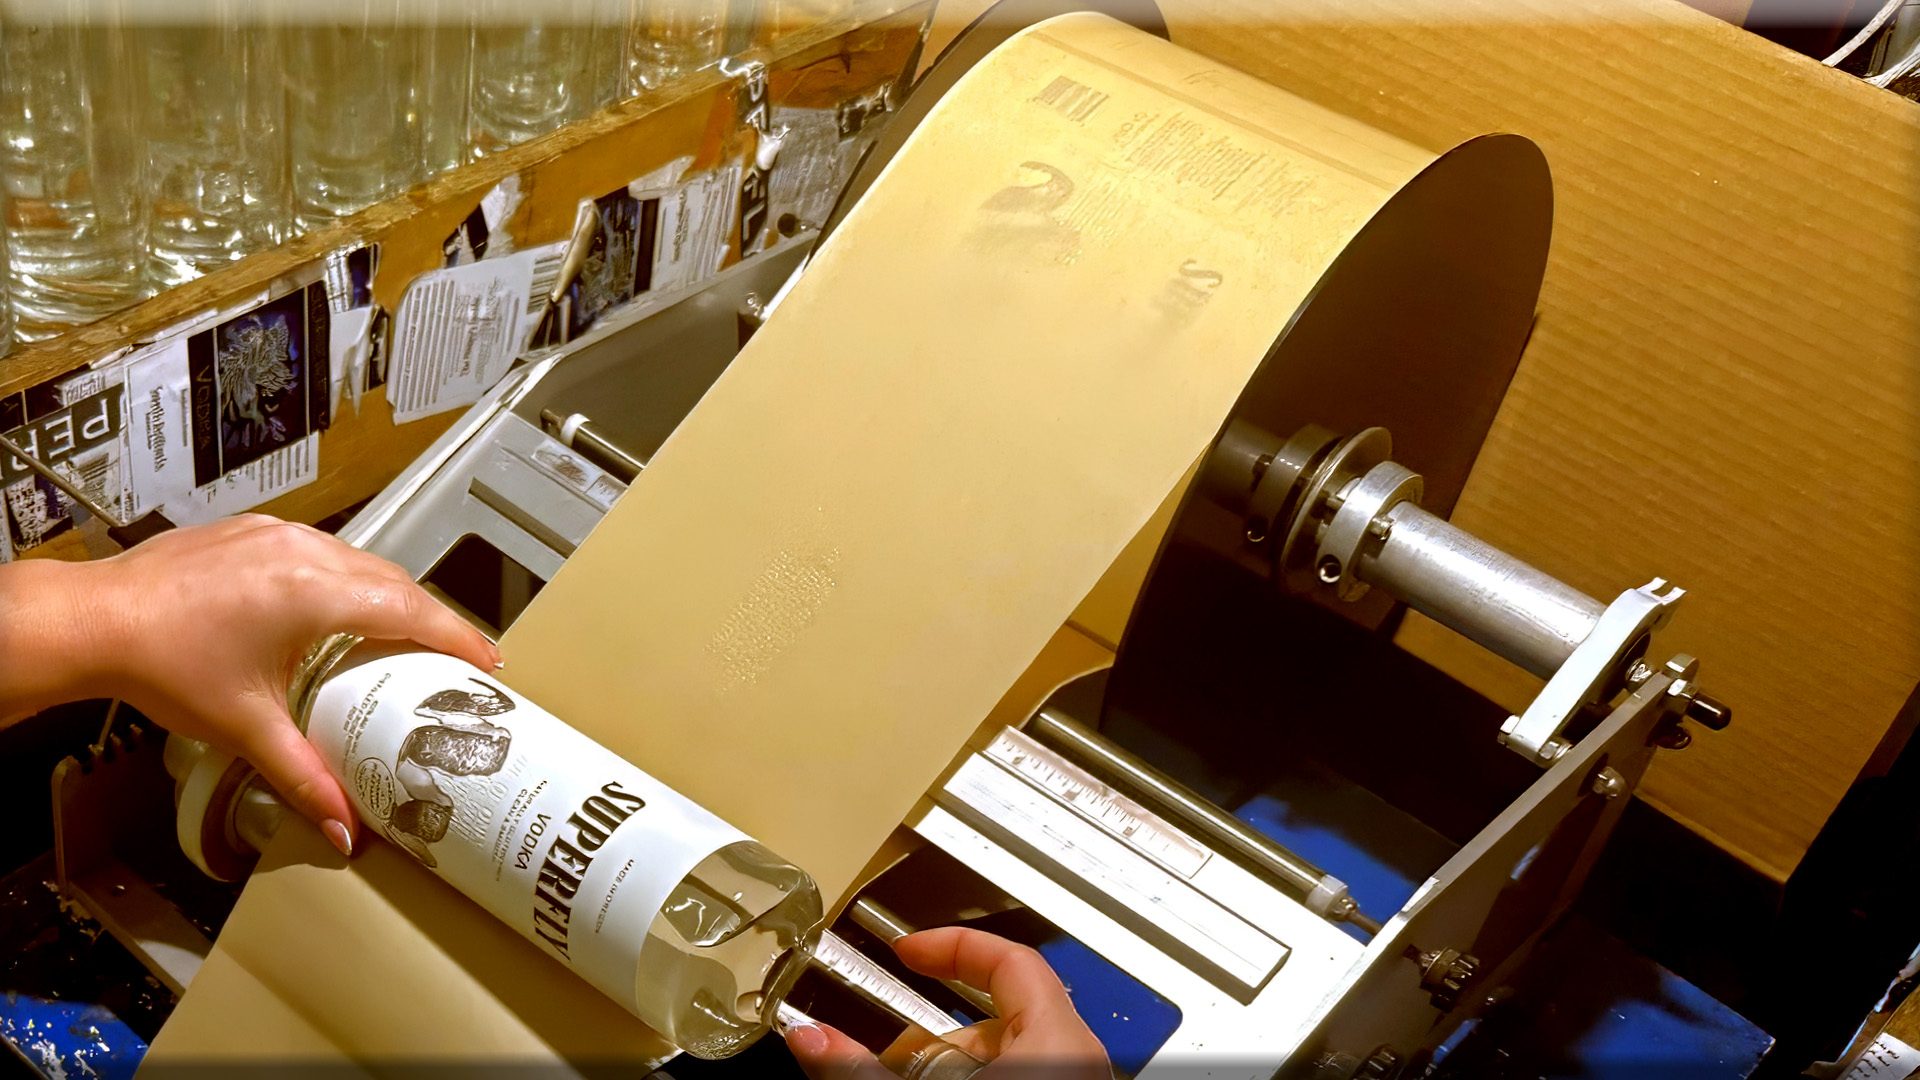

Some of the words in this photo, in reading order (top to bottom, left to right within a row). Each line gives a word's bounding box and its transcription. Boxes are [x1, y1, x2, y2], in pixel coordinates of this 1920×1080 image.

[0, 398, 109, 476] PER
[506, 787, 528, 817] CLEAN
[513, 812, 551, 869] VODKA
[533, 781, 645, 960] SUPERFLY
